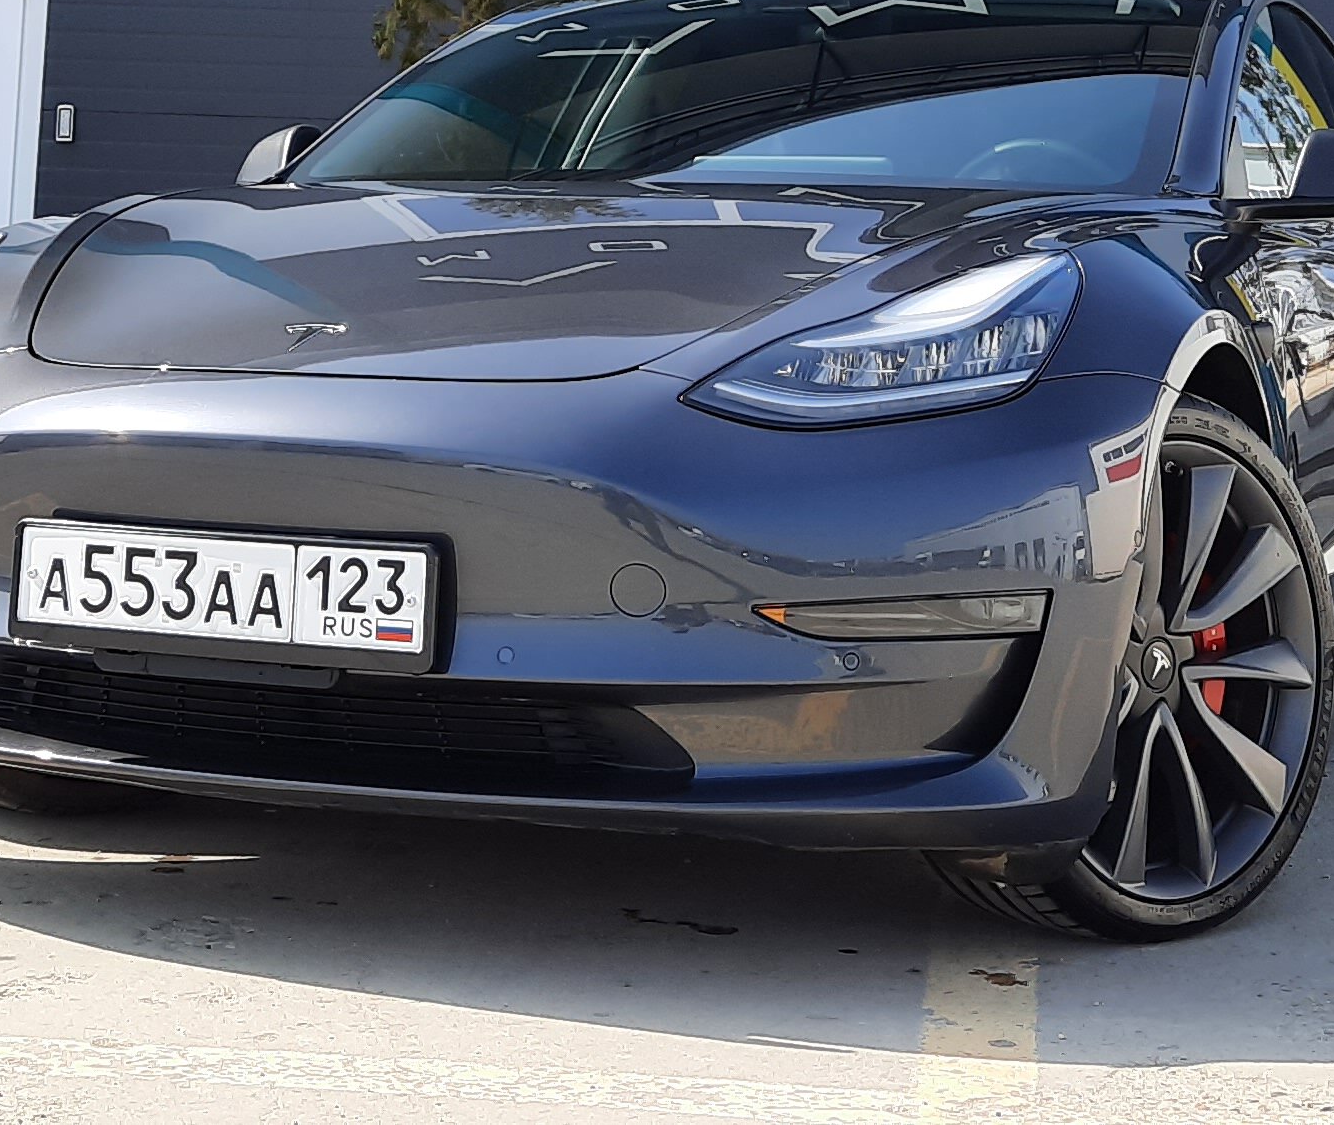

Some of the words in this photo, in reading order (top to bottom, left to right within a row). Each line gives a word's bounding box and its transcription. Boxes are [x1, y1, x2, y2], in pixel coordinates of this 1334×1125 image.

[39, 544, 283, 629] A553AA
[305, 555, 407, 616] 123
[322, 617, 374, 639] RUS
